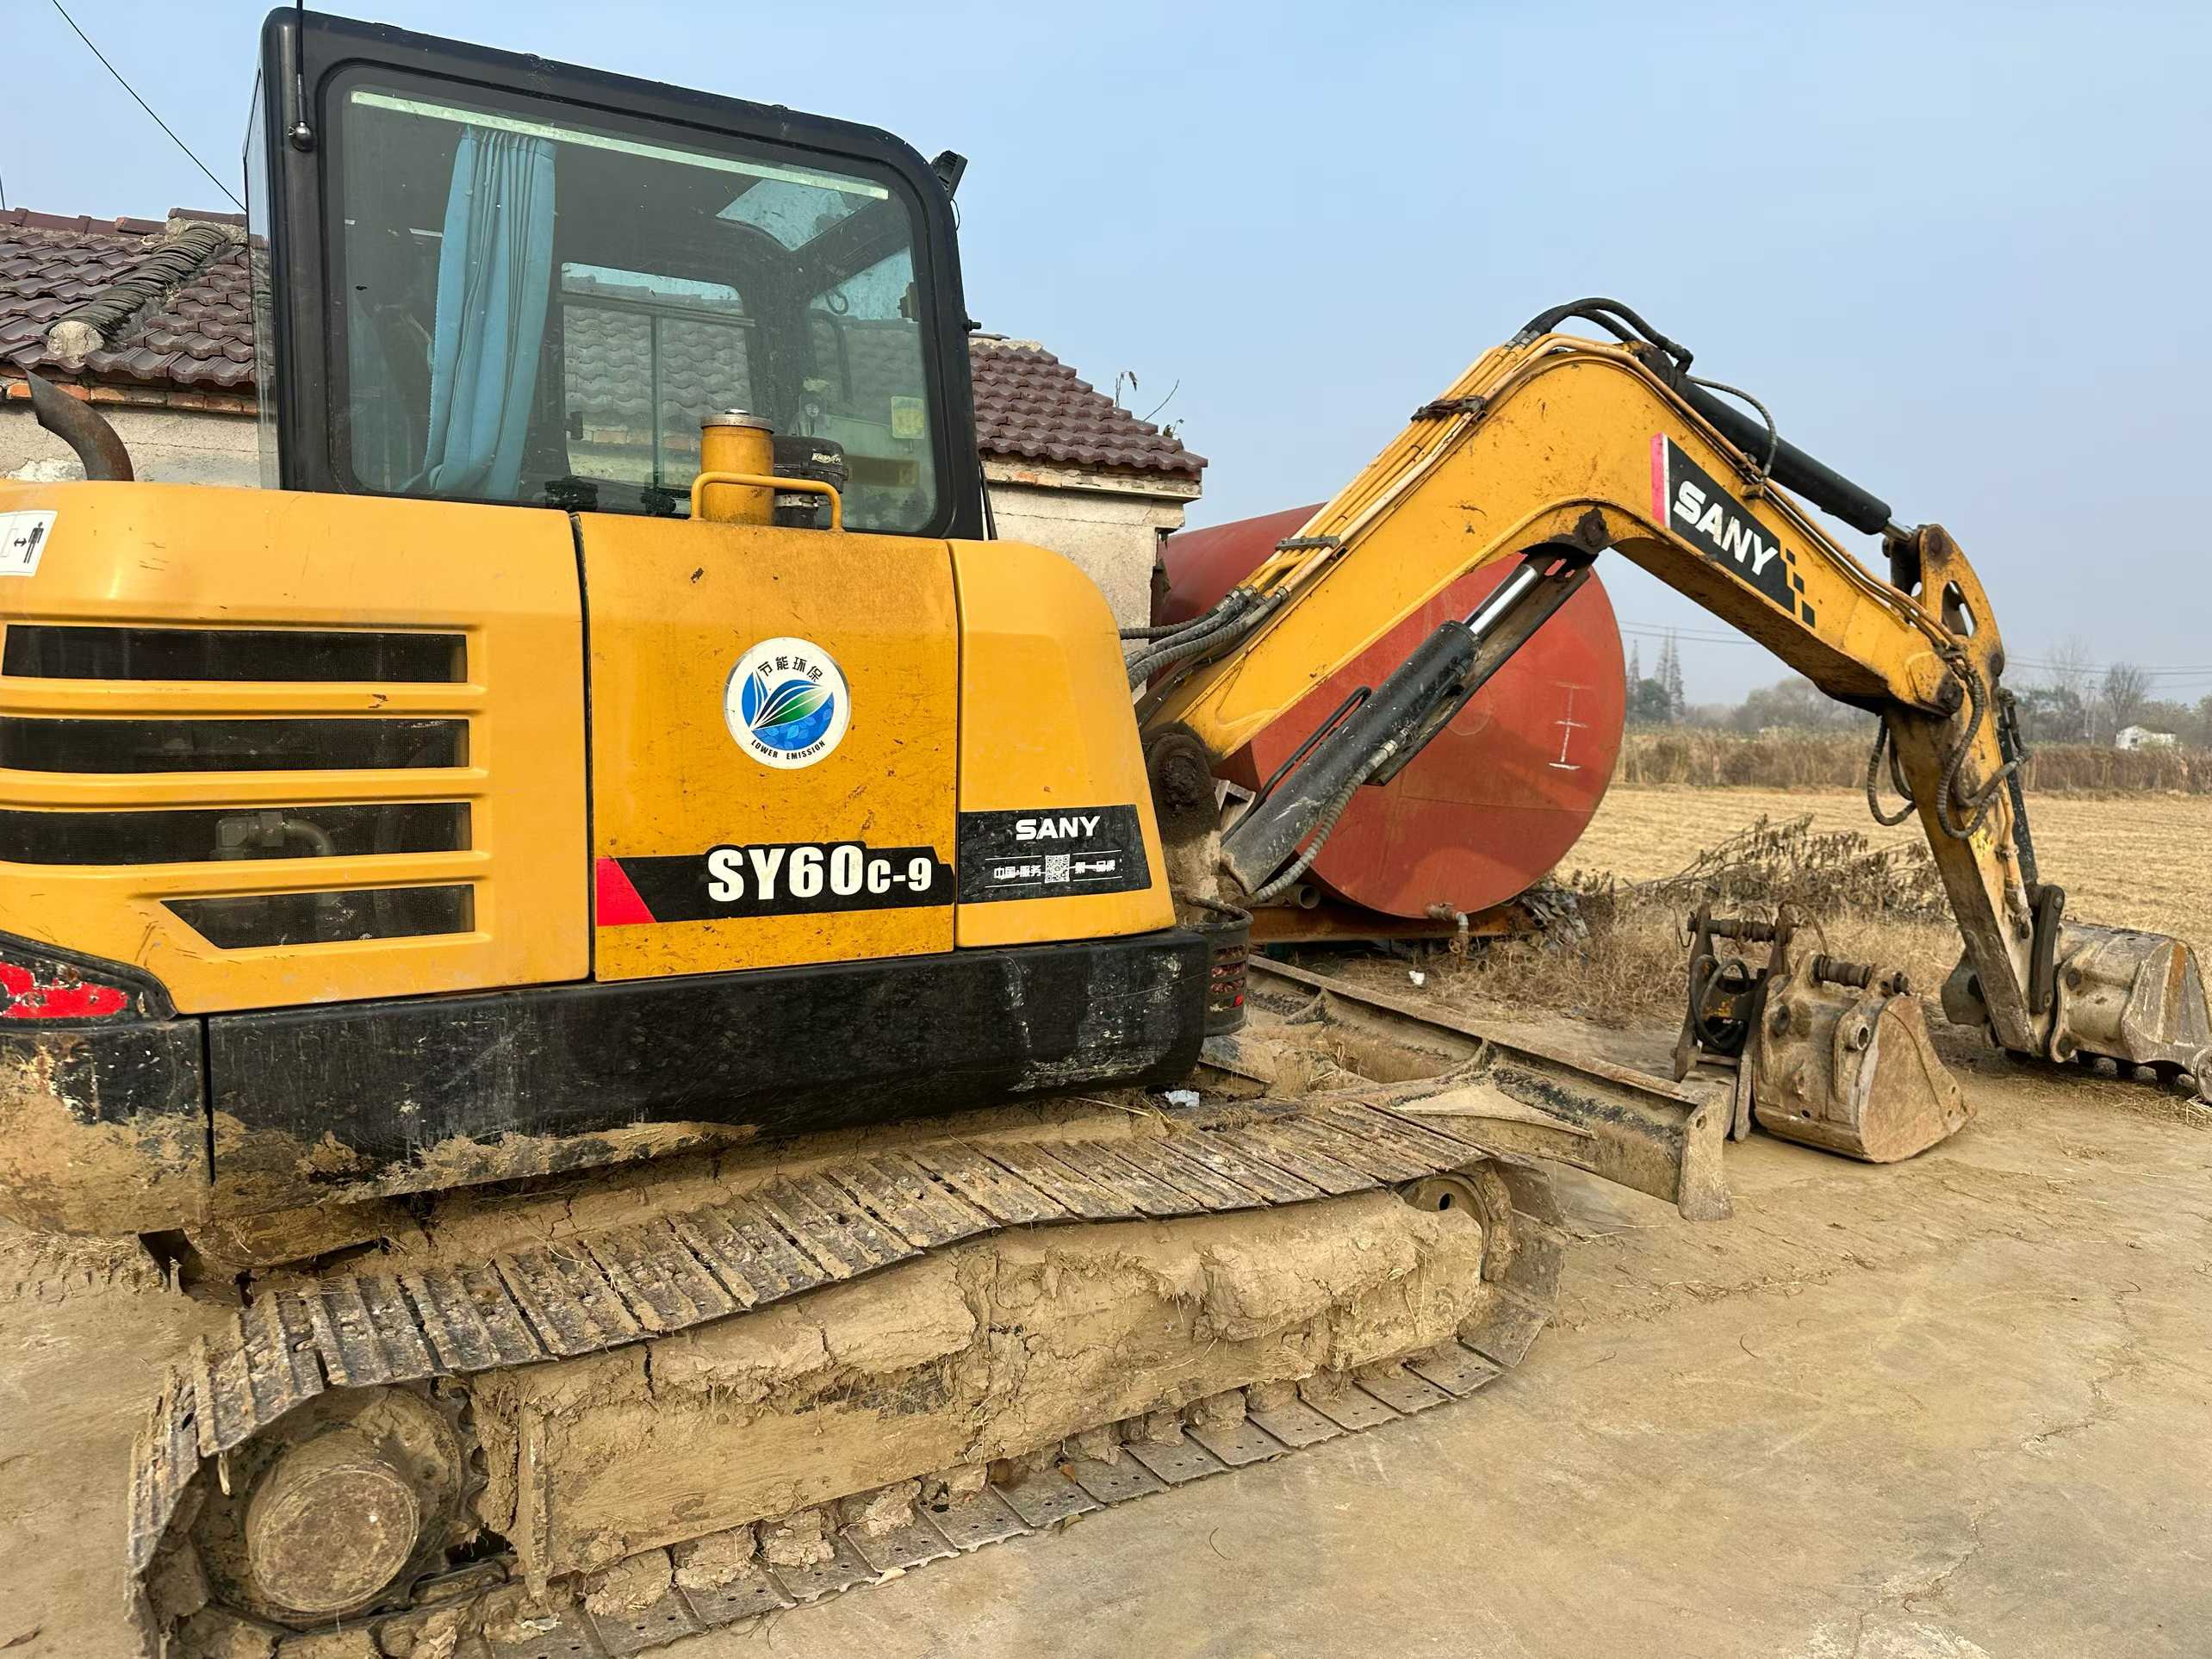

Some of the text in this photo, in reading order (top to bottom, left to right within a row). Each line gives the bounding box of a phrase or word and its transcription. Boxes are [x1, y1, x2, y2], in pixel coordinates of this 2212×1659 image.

[1673, 481, 1779, 576] SANY
[757, 656, 823, 682] 节能环保
[750, 739, 826, 760] LOWER EMISSION
[1016, 816, 1101, 841] SANY
